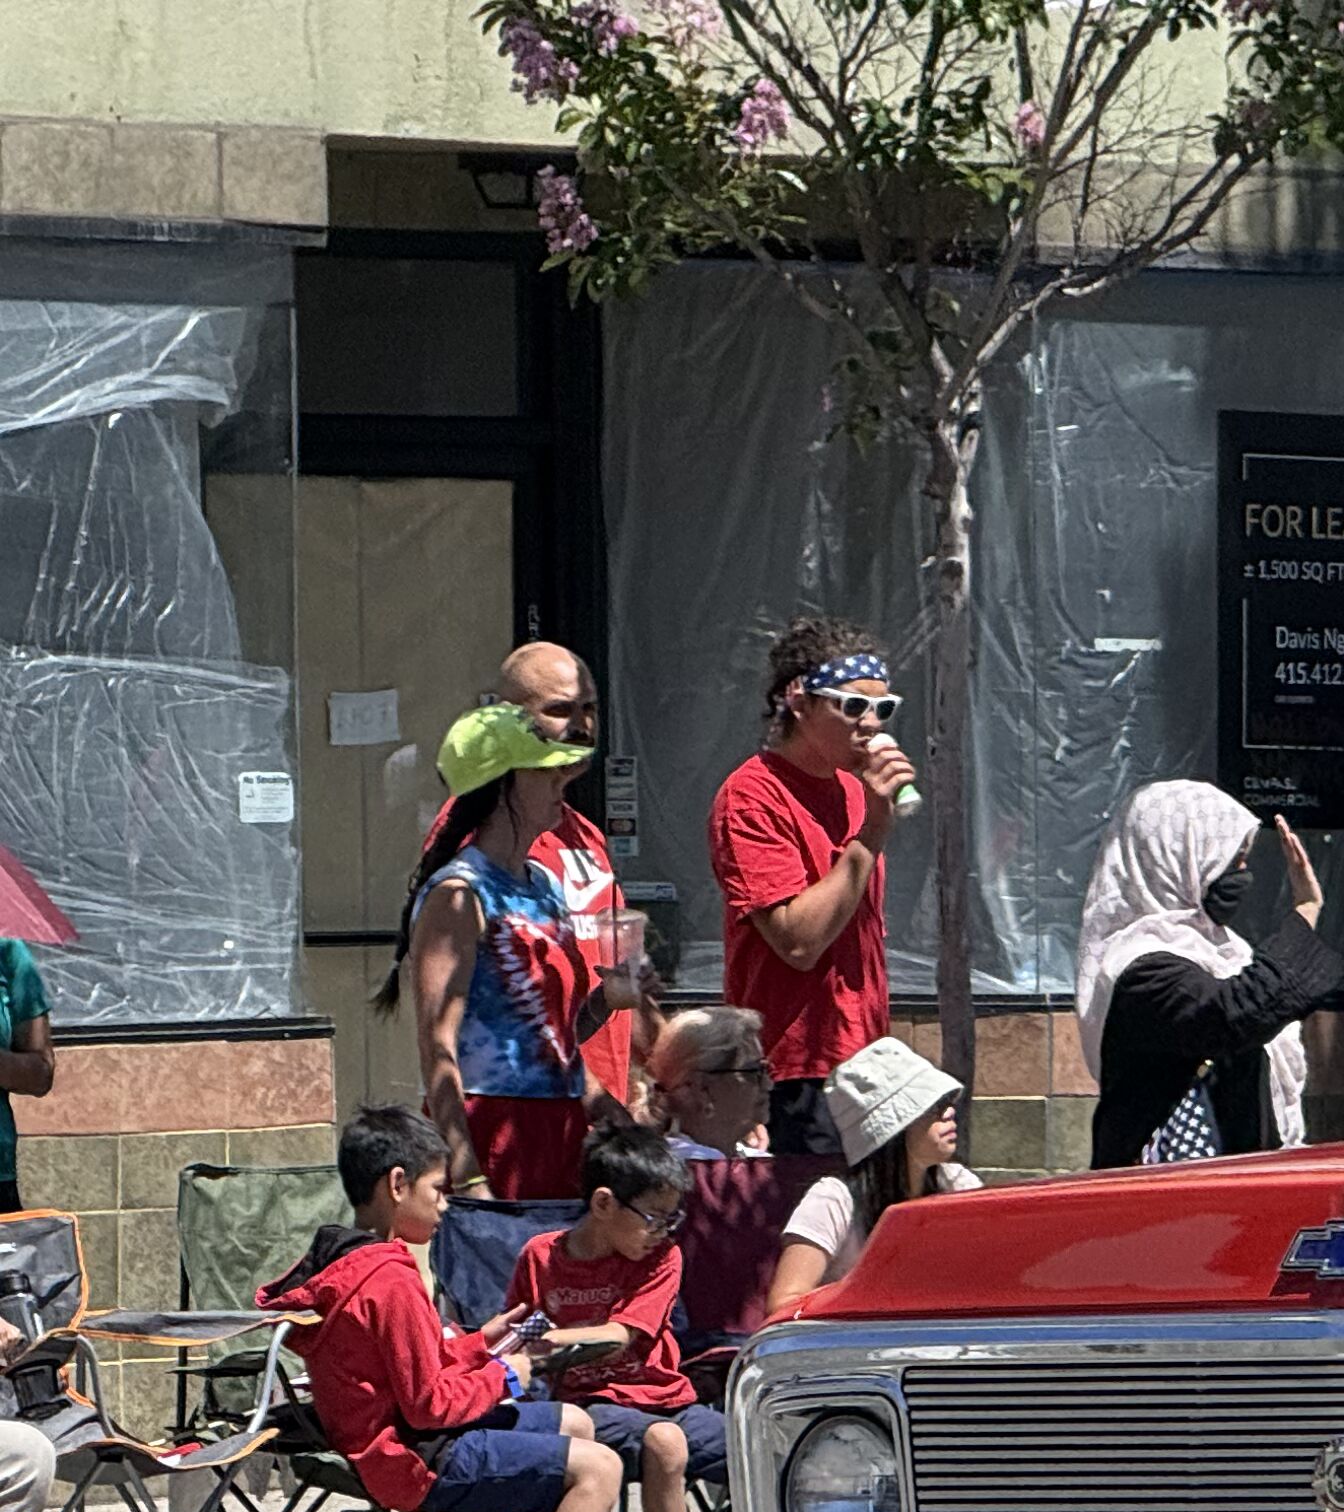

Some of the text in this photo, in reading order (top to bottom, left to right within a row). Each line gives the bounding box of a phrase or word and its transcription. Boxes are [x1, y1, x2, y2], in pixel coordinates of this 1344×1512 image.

[1245, 504, 1301, 538] FOR
[1258, 560, 1298, 581] 1,500
[1301, 561, 1324, 583] SQ
[1327, 563, 1344, 581] FT
[1275, 626, 1320, 649] Davis
